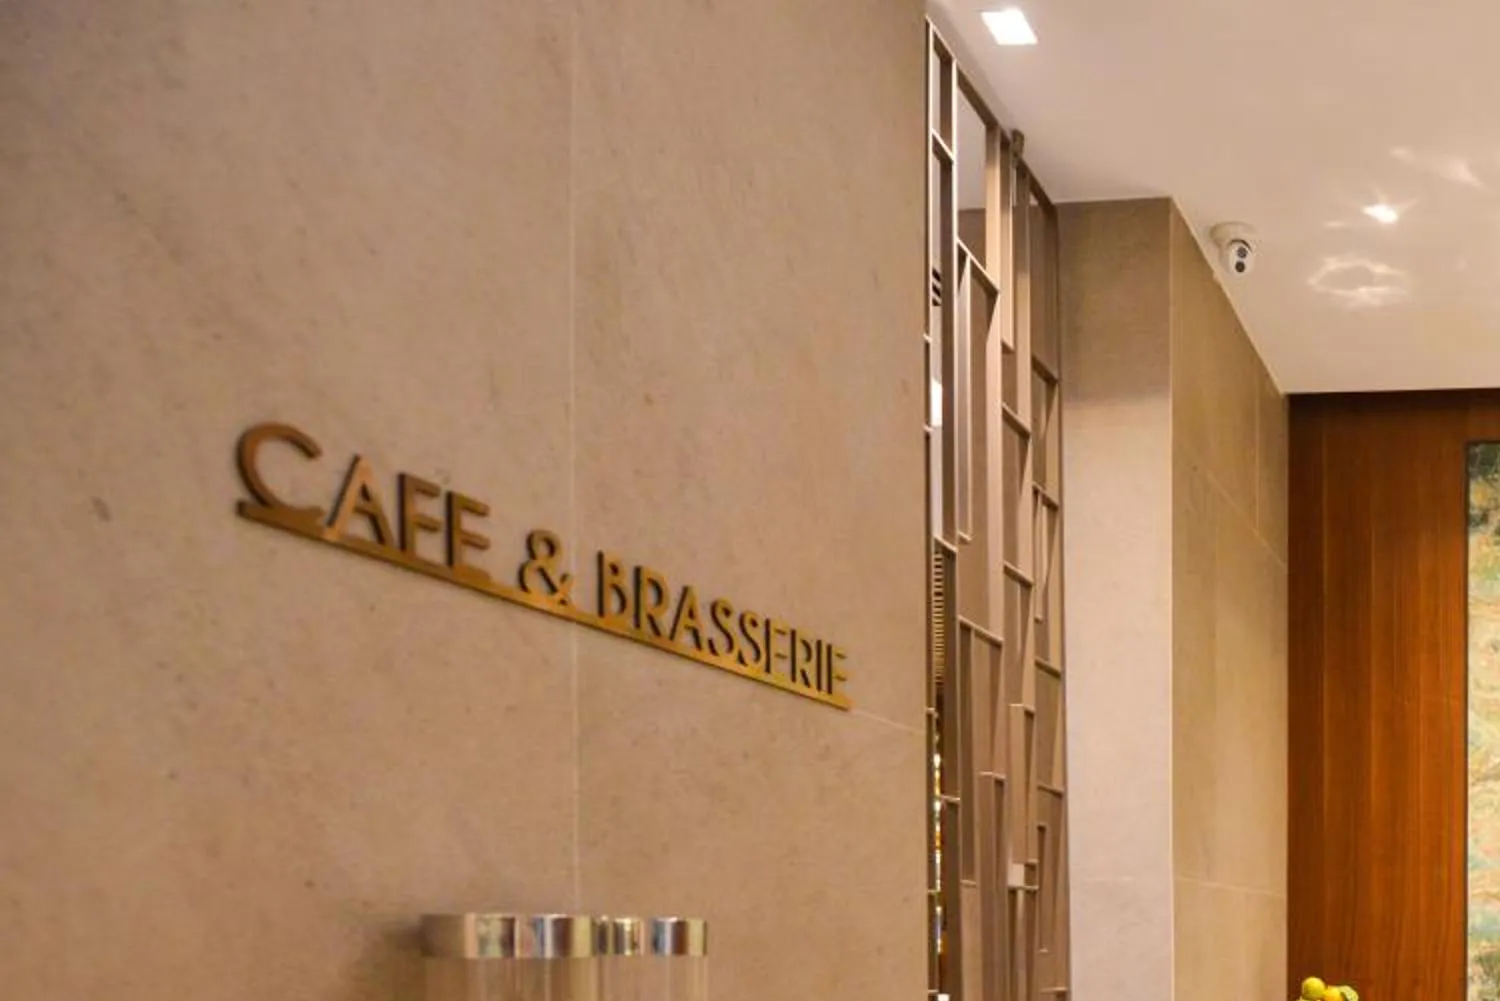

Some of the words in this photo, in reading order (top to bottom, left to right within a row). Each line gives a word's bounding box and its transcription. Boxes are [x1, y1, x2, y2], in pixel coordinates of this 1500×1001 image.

[235, 421, 491, 581] CAFE
[518, 528, 573, 606] &
[597, 550, 849, 701] BRASSERIE
